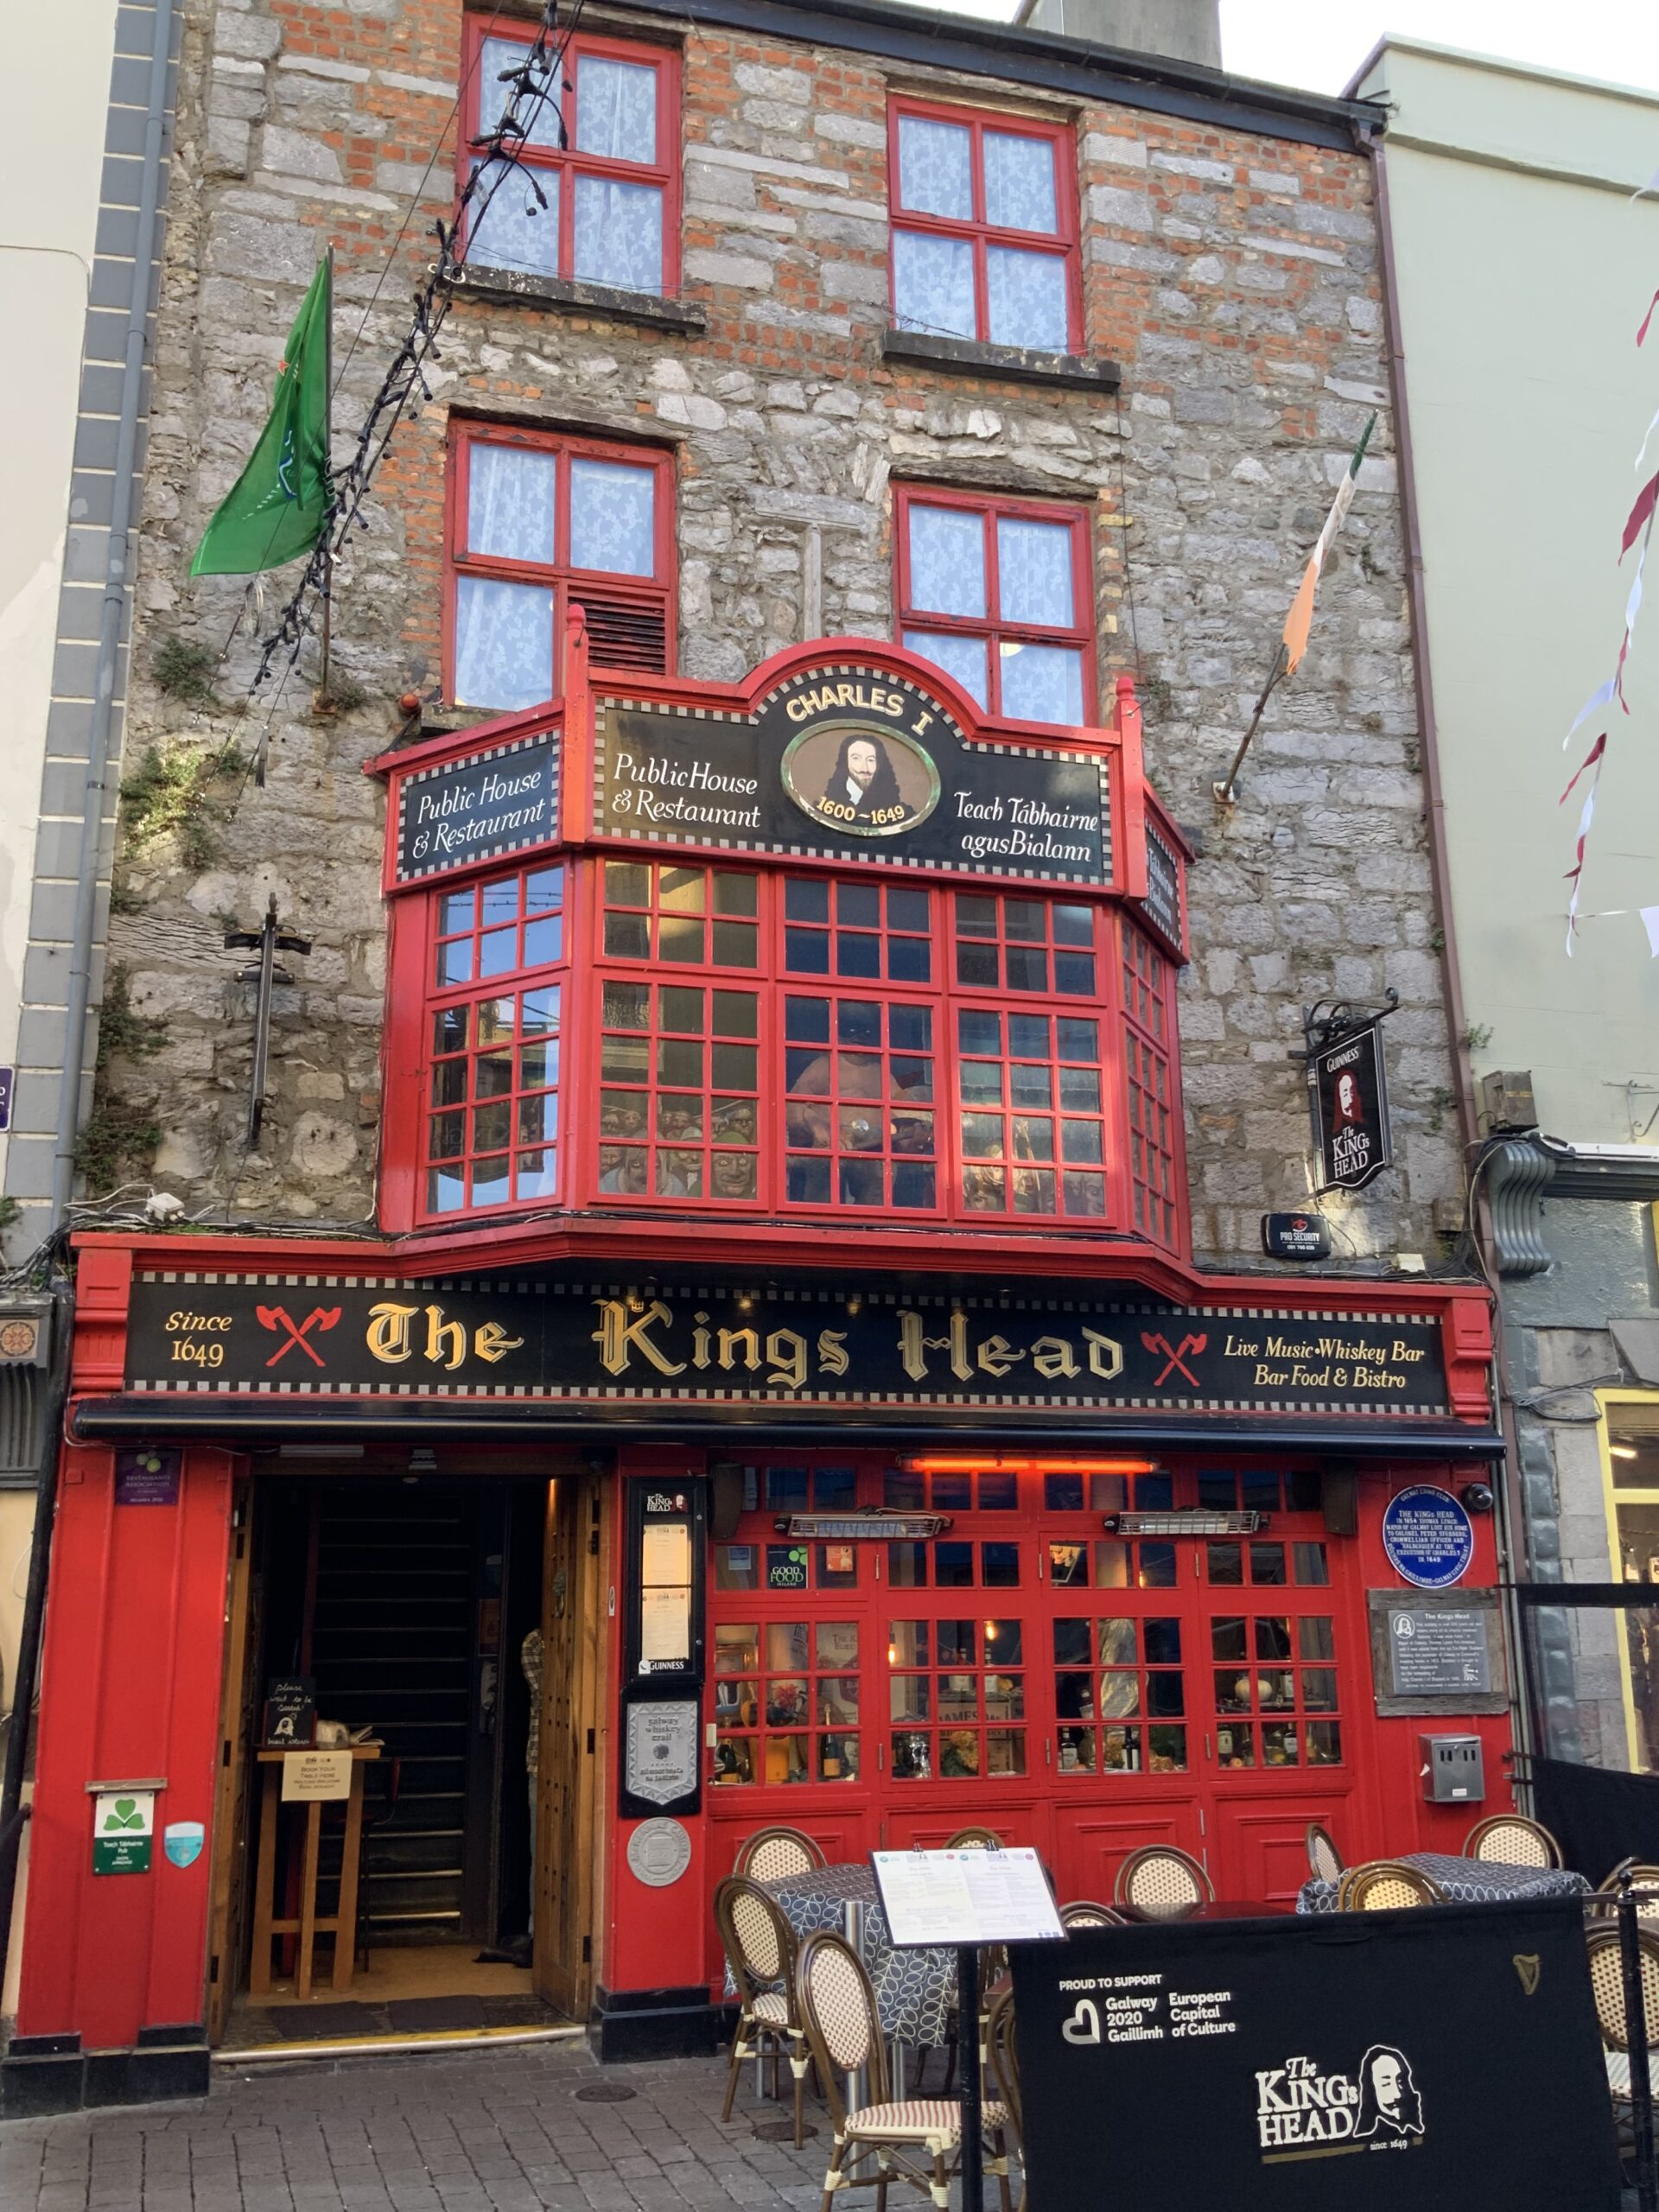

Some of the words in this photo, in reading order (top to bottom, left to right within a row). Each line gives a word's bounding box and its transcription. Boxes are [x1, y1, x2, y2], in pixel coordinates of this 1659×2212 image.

[786, 684, 905, 721] CHARLES
[911, 711, 934, 736] I
[613, 753, 688, 787] Public
[689, 761, 758, 795] House
[417, 785, 474, 824] Public
[480, 772, 541, 806] House
[612, 790, 632, 812] &
[636, 790, 761, 828] Restaurant
[954, 792, 1002, 822] Teach
[1007, 798, 1098, 832] Tábhairne
[413, 832, 428, 859] &
[435, 798, 545, 853] Restaurant
[961, 835, 1008, 858] agus
[1010, 830, 1091, 863] Bialann
[1326, 1046, 1359, 1073] GUINNESS
[1342, 1126, 1354, 1140] The
[1334, 1150, 1368, 1179] HEAD
[1280, 1231, 1292, 1241] PRO
[1294, 1232, 1319, 1242] SECURITY
[165, 1312, 232, 1332] Since
[171, 1337, 223, 1368] 1649
[365, 1302, 524, 1370] The
[591, 1299, 849, 1389] Kings
[896, 1309, 1124, 1382] Head
[1224, 1335, 1258, 1357] Live
[1391, 1340, 1425, 1362] Bar
[1254, 1364, 1288, 1385] Bar
[1291, 1365, 1330, 1386] Food
[1333, 1367, 1347, 1387] &
[1352, 1365, 1406, 1388] Bistro
[771, 1573, 804, 1583] FOOD
[772, 1566, 800, 1574] GOOD
[649, 1661, 684, 1670] GUINNESS
[1059, 1979, 1096, 1991] PROUD
[1097, 1978, 1113, 1988] TO
[1115, 1974, 1162, 1987] SUPPORT
[1106, 1996, 1158, 2012] Galway
[1169, 1992, 1230, 2006] European
[1107, 2012, 1142, 2026] 2020
[1171, 2005, 1220, 2023] Capital
[1108, 2026, 1163, 2043] Gaillimh
[1172, 2024, 1185, 2037] of
[1187, 2022, 1236, 2036] Culture
[1286, 2056, 1317, 2079] The
[1257, 2107, 1353, 2147] HEAD
[1370, 2141, 1388, 2151] since
[1390, 2139, 1408, 2151] 1649
